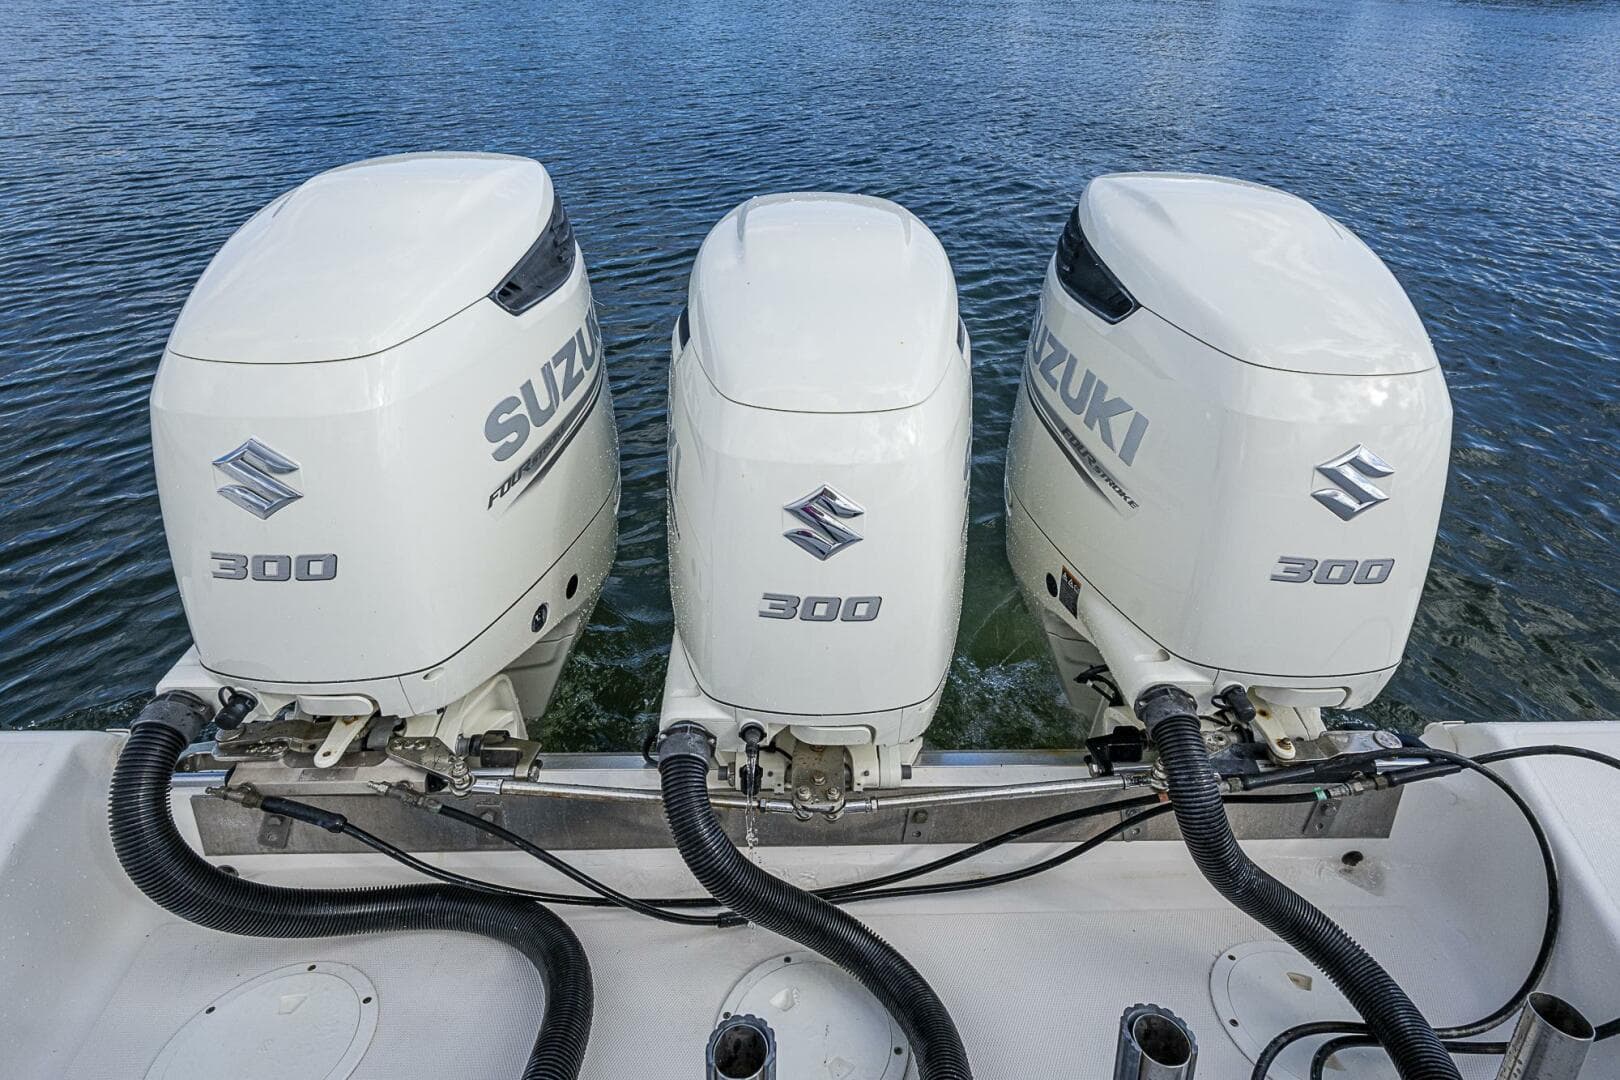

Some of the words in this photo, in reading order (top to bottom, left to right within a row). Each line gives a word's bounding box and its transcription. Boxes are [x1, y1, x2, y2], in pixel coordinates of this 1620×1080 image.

[210, 552, 338, 581] 300
[1270, 556, 1395, 584] 300
[758, 592, 883, 622] 300
